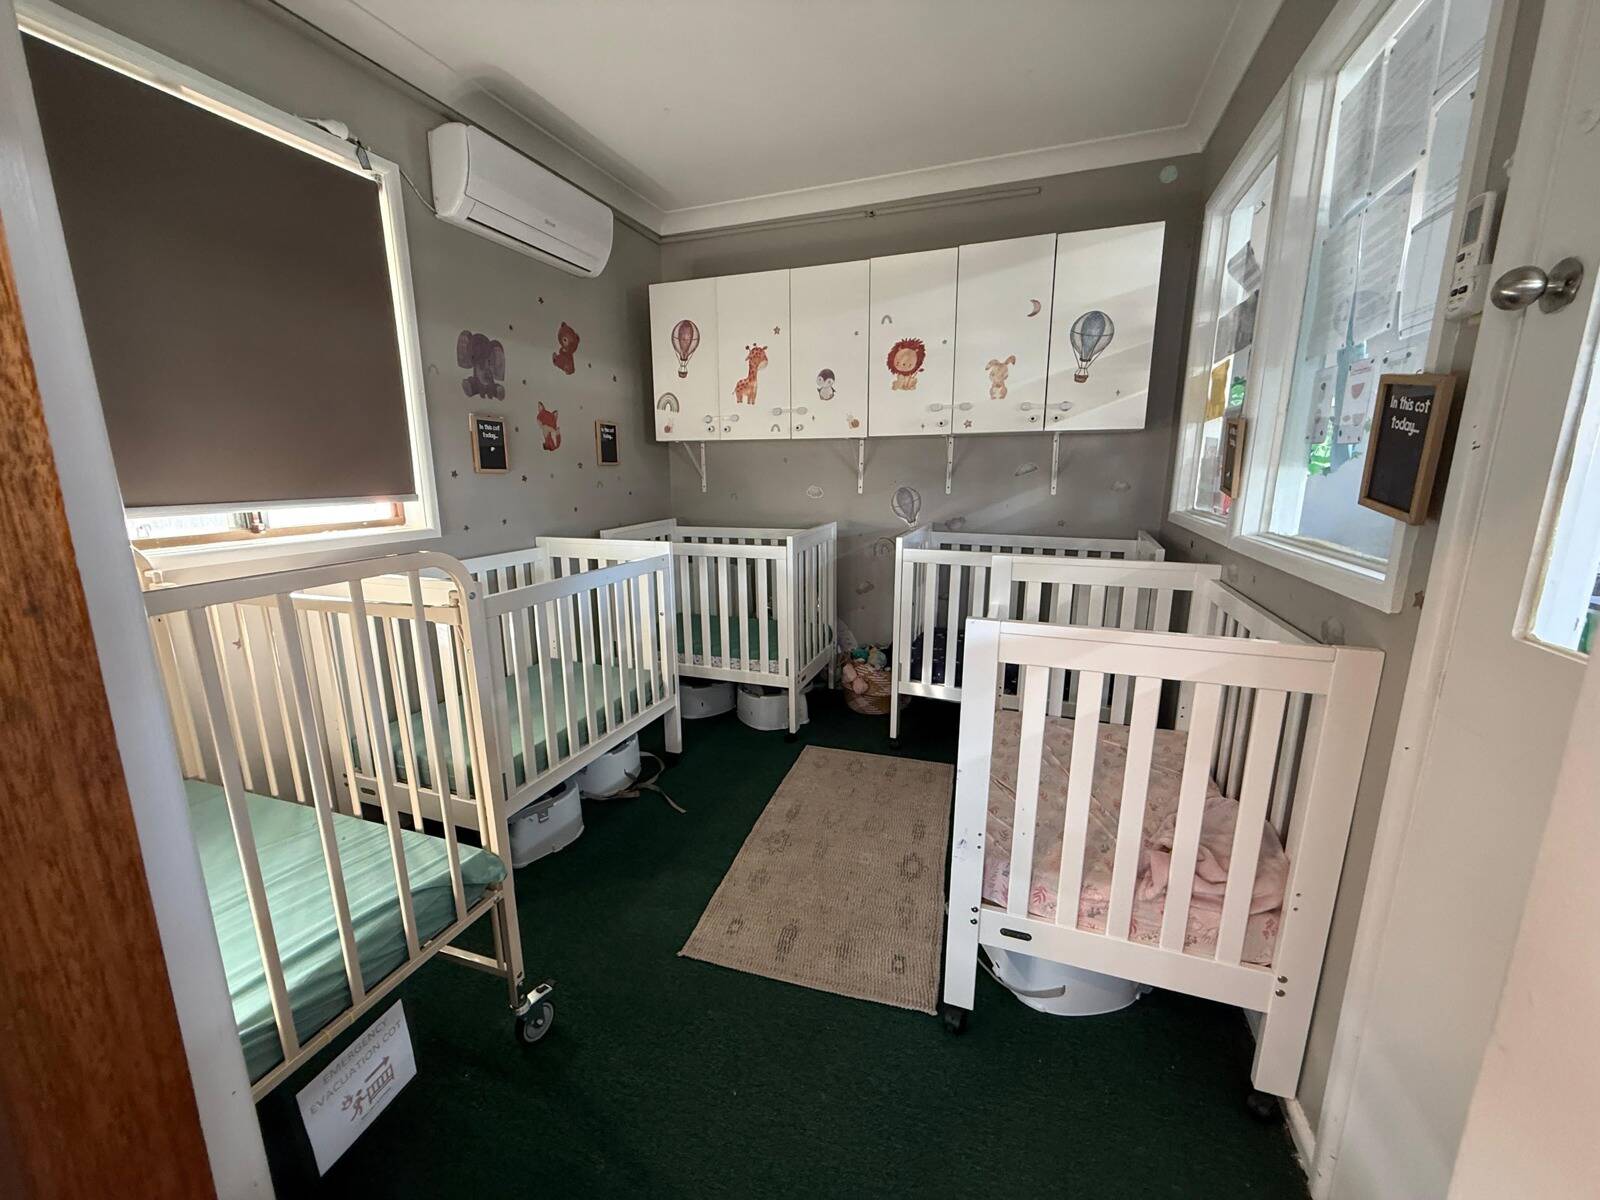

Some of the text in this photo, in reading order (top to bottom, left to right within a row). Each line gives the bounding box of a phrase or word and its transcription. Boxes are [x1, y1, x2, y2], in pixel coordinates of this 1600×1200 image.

[1390, 395, 1431, 414] In this cot
[311, 1021, 401, 1113] EVACUATION COT
[323, 1020, 387, 1084] EMERGENCY
